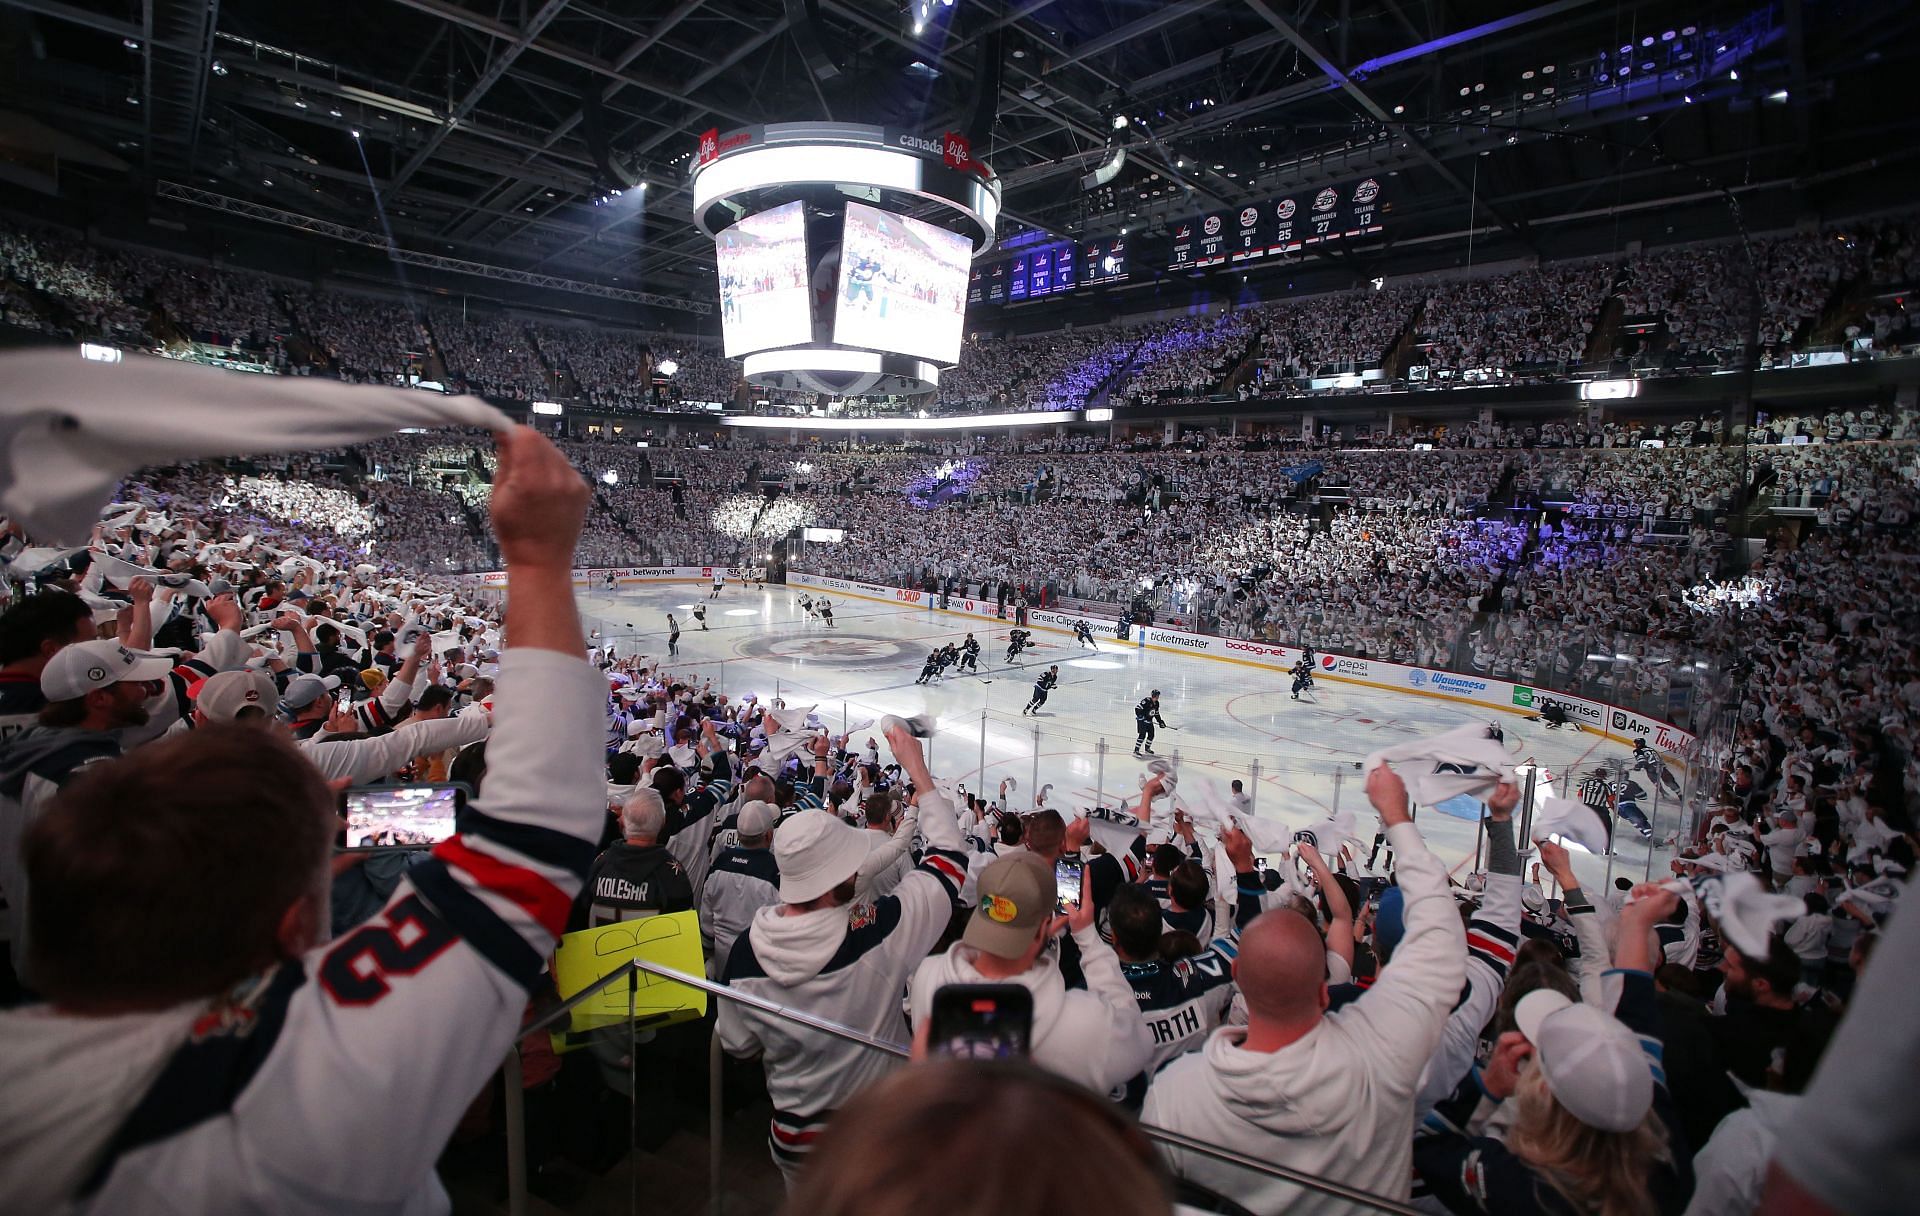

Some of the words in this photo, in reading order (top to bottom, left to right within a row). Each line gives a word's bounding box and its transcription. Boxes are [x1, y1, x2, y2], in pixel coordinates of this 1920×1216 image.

[899, 134, 944, 155] canada
[946, 140, 969, 164] life
[1359, 213, 1371, 226] 13
[1316, 221, 1330, 233] 27
[1278, 228, 1292, 241] 25
[1244, 236, 1251, 247] 8
[1205, 243, 1217, 255] 10
[1176, 251, 1187, 263] 15
[1061, 272, 1067, 282] 4
[1089, 268, 1095, 278] 9
[1035, 277, 1044, 287] 14
[633, 568, 676, 577] betway.net
[822, 579, 851, 590] NISSAN
[903, 590, 921, 603] SKIP
[936, 597, 965, 610] SEWAY
[1031, 611, 1055, 623] Great
[1085, 621, 1120, 634] Paywork
[1150, 631, 1210, 649] ticketmaster
[1225, 640, 1287, 657] bodog.net
[1338, 659, 1369, 671] pepsi
[1431, 672, 1487, 691] Wawanesa
[1438, 684, 1473, 695] Insurance
[1627, 719, 1650, 735] App
[1586, 785, 1599, 794] 27
[595, 877, 650, 901] KOLESAR
